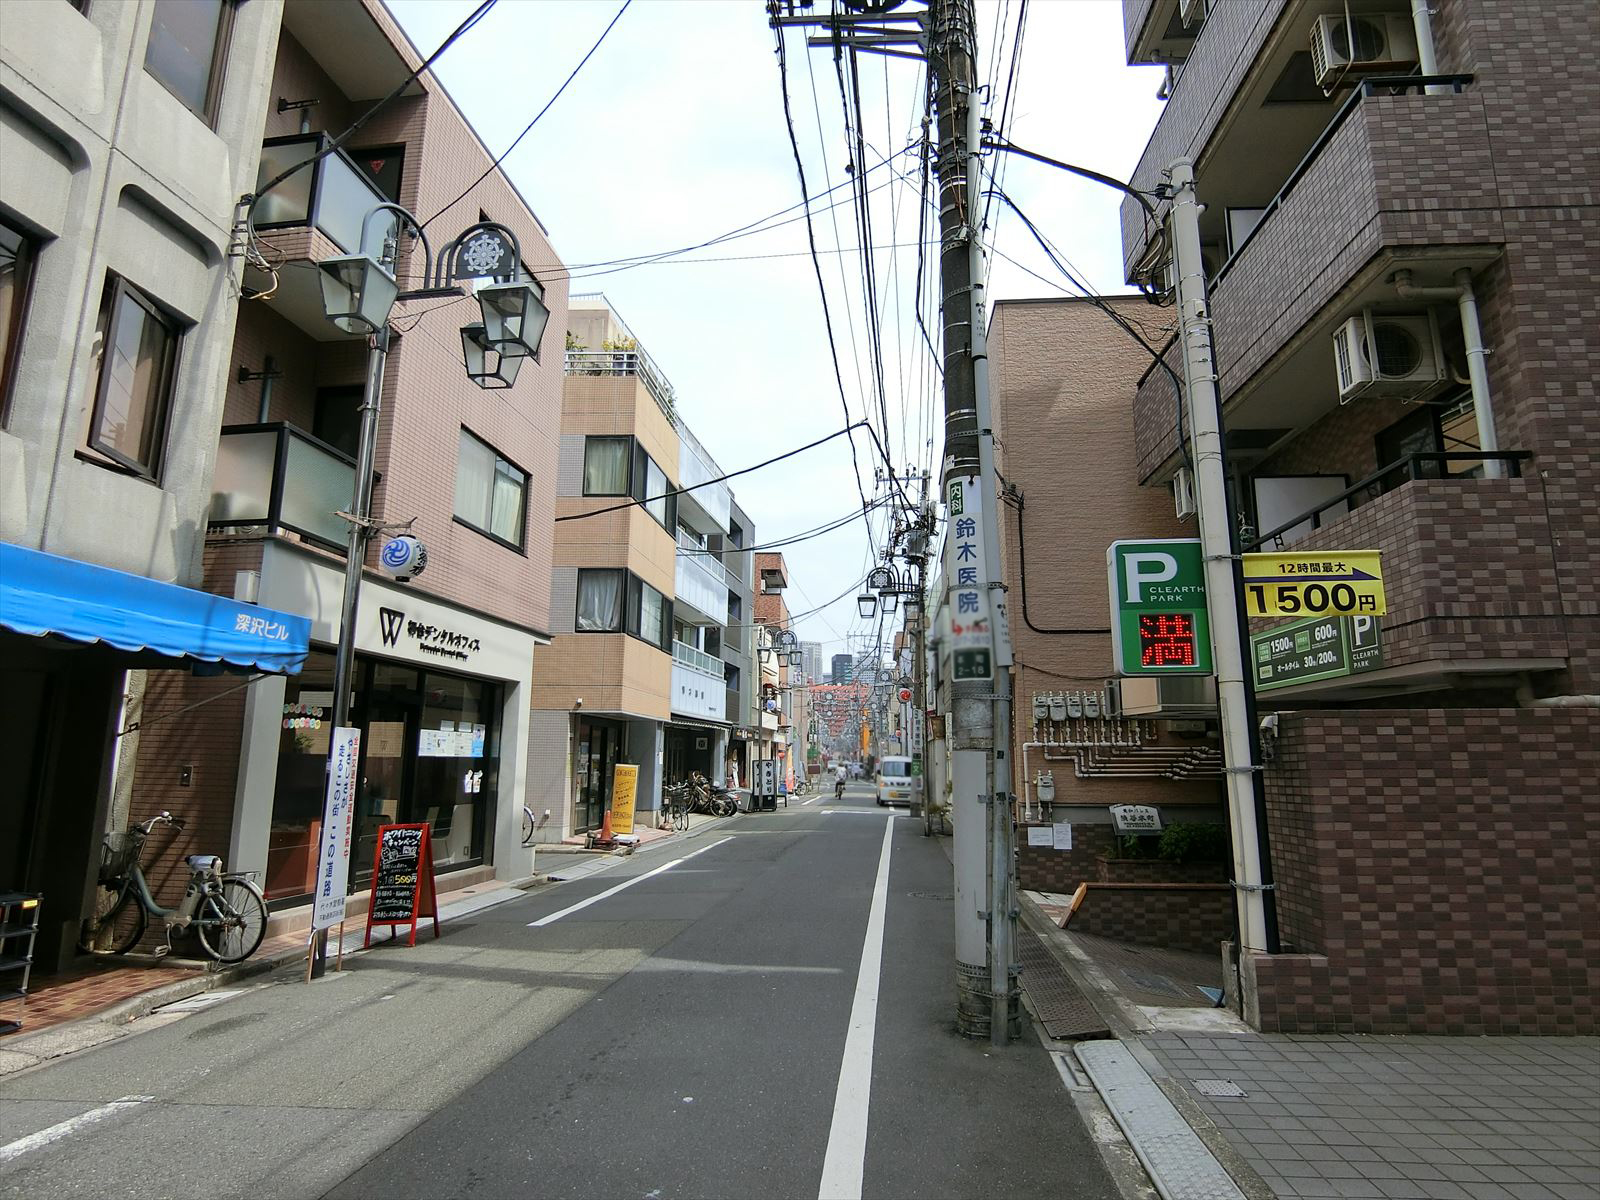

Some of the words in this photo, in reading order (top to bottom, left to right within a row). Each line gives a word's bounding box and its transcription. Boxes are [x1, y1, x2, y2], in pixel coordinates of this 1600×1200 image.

[951, 485, 962, 513] 内科
[956, 517, 979, 614] 鈴木医院
[1279, 562, 1347, 574] 12時間最大
[1122, 552, 1178, 603] P
[1249, 583, 1376, 613] 1500円
[235, 613, 289, 640] 深沢ビル
[1140, 615, 1193, 665] 満
[1352, 650, 1379, 660] CLEARTH
[957, 665, 984, 676] 2-18
[1277, 660, 1300, 673] オールタイム
[1353, 661, 1369, 669] PARK
[383, 829, 422, 841] ホワイトニング
[388, 839, 418, 847] キャンペーン
